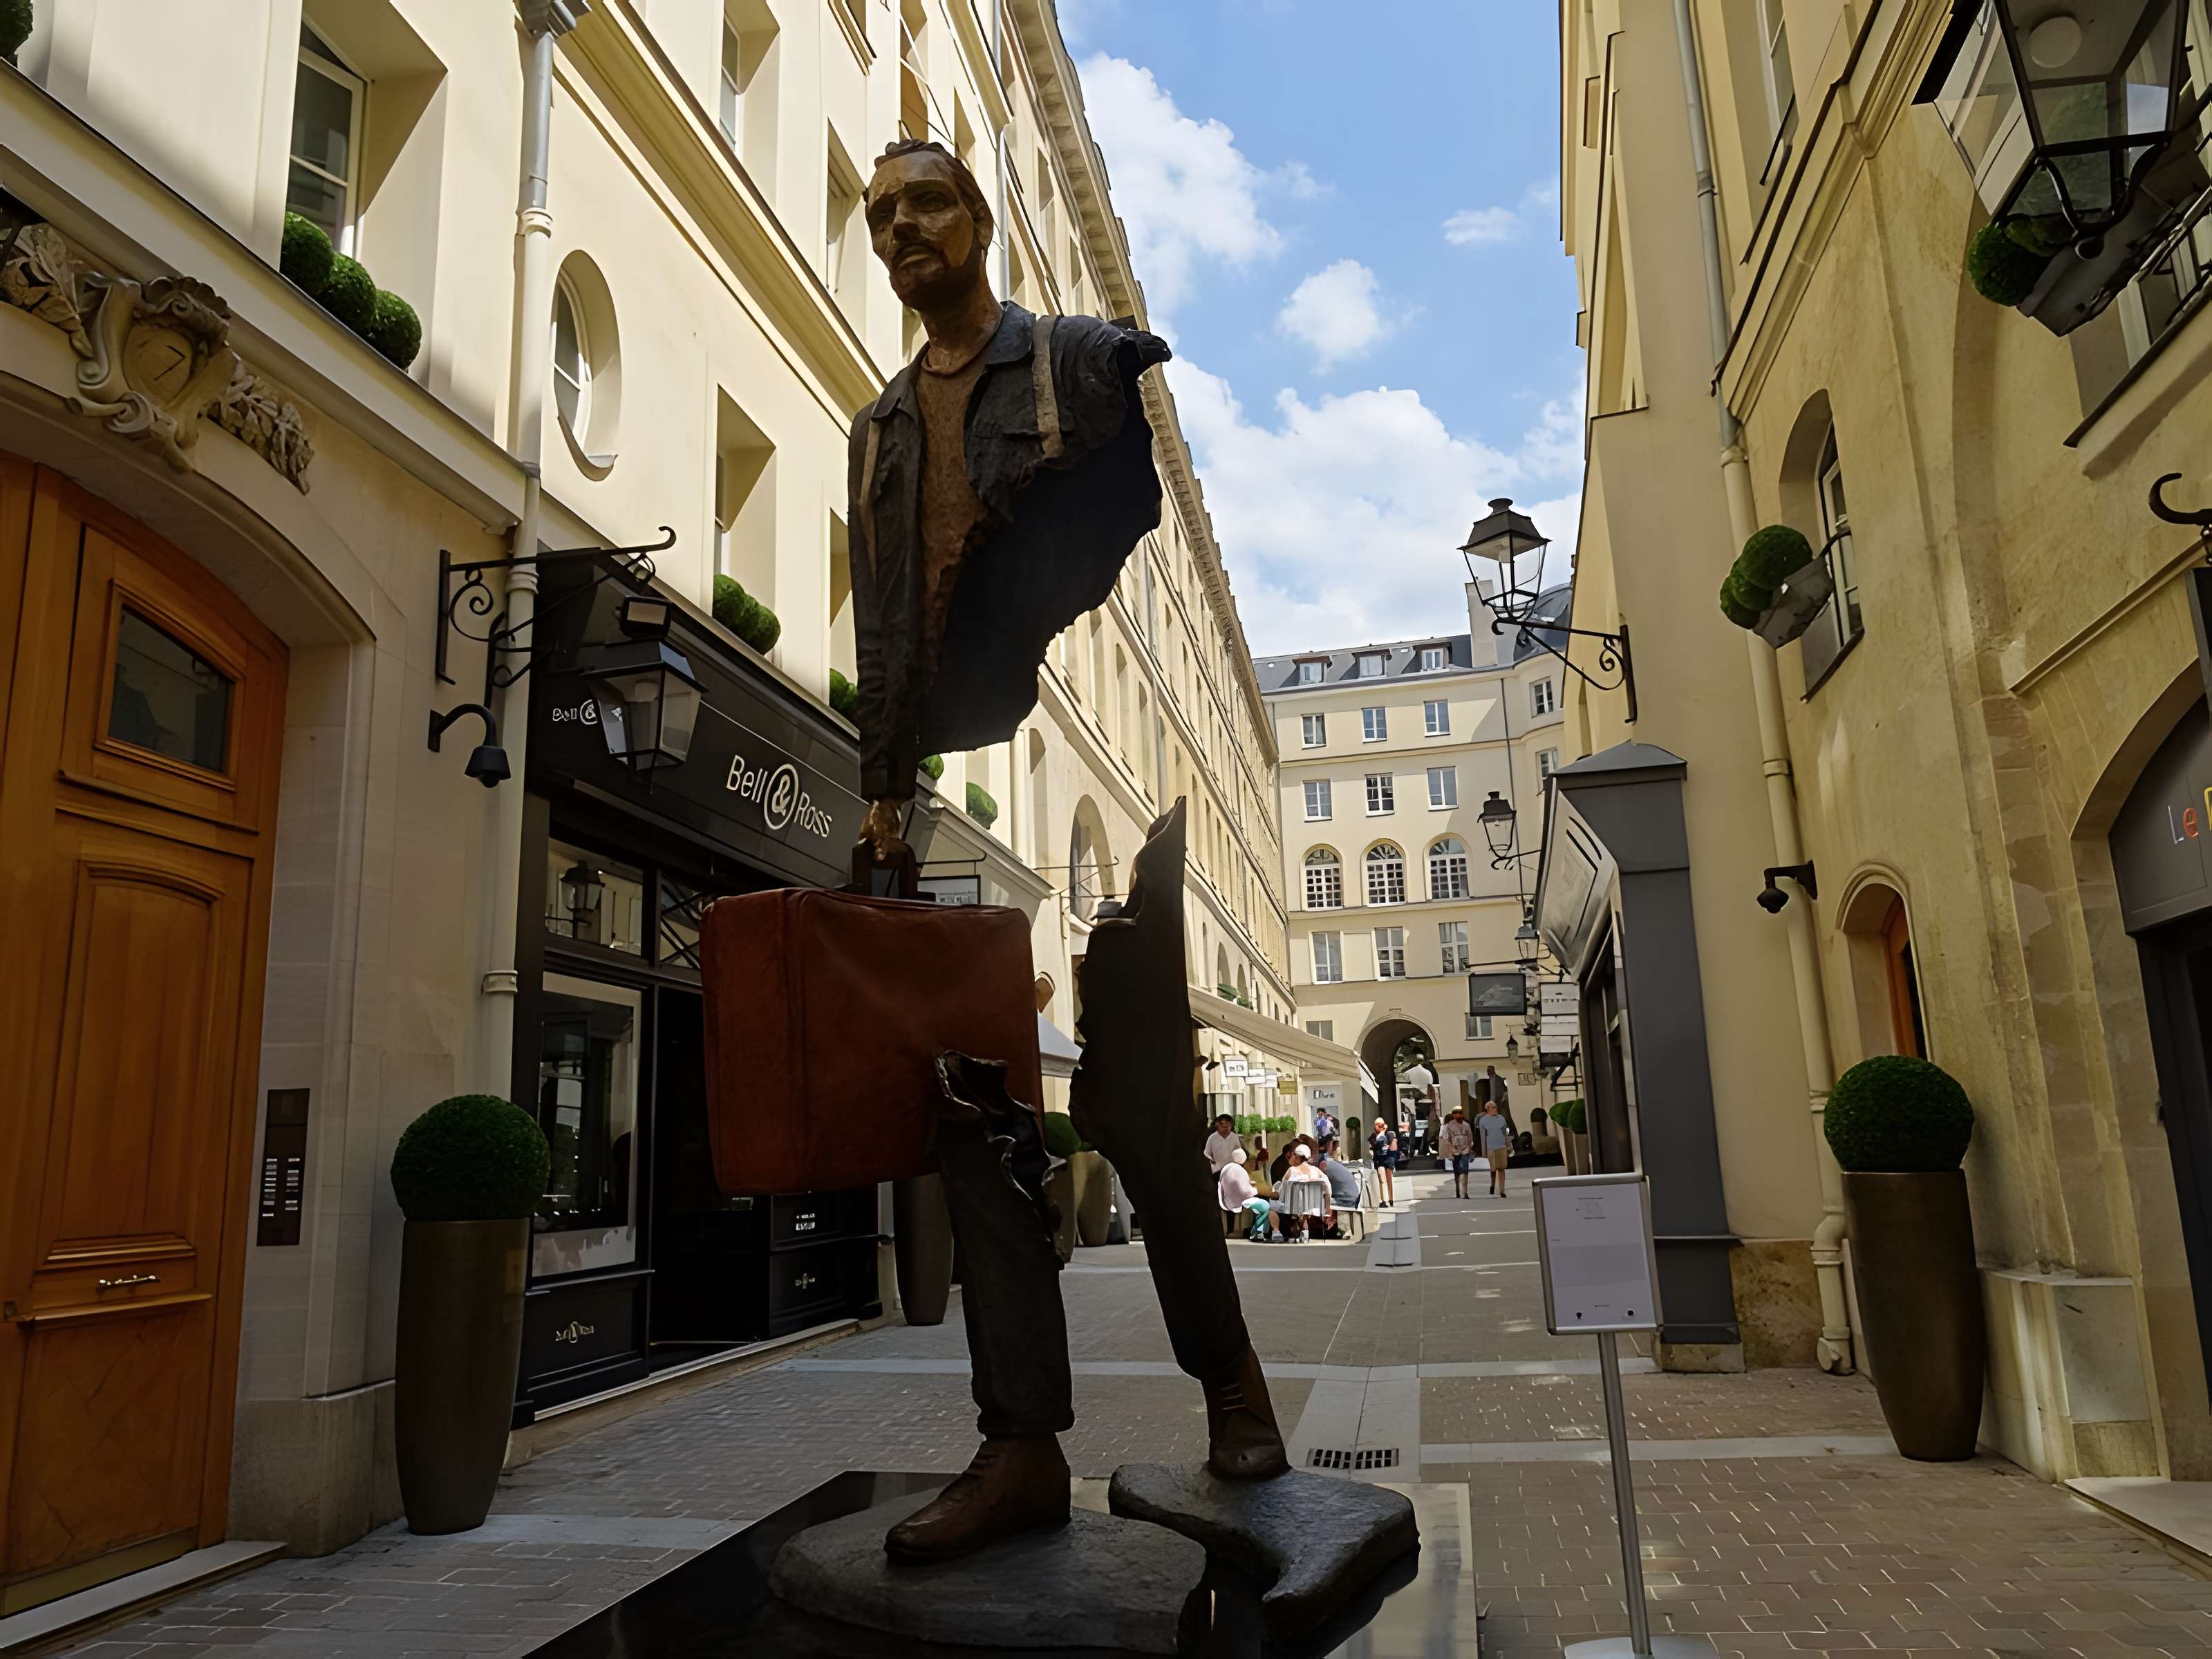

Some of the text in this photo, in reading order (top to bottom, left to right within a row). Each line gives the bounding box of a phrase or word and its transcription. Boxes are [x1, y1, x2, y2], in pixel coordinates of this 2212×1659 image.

[726, 754, 769, 803] Bell
[794, 791, 832, 838] Ross
[2167, 805, 2199, 845] Le
